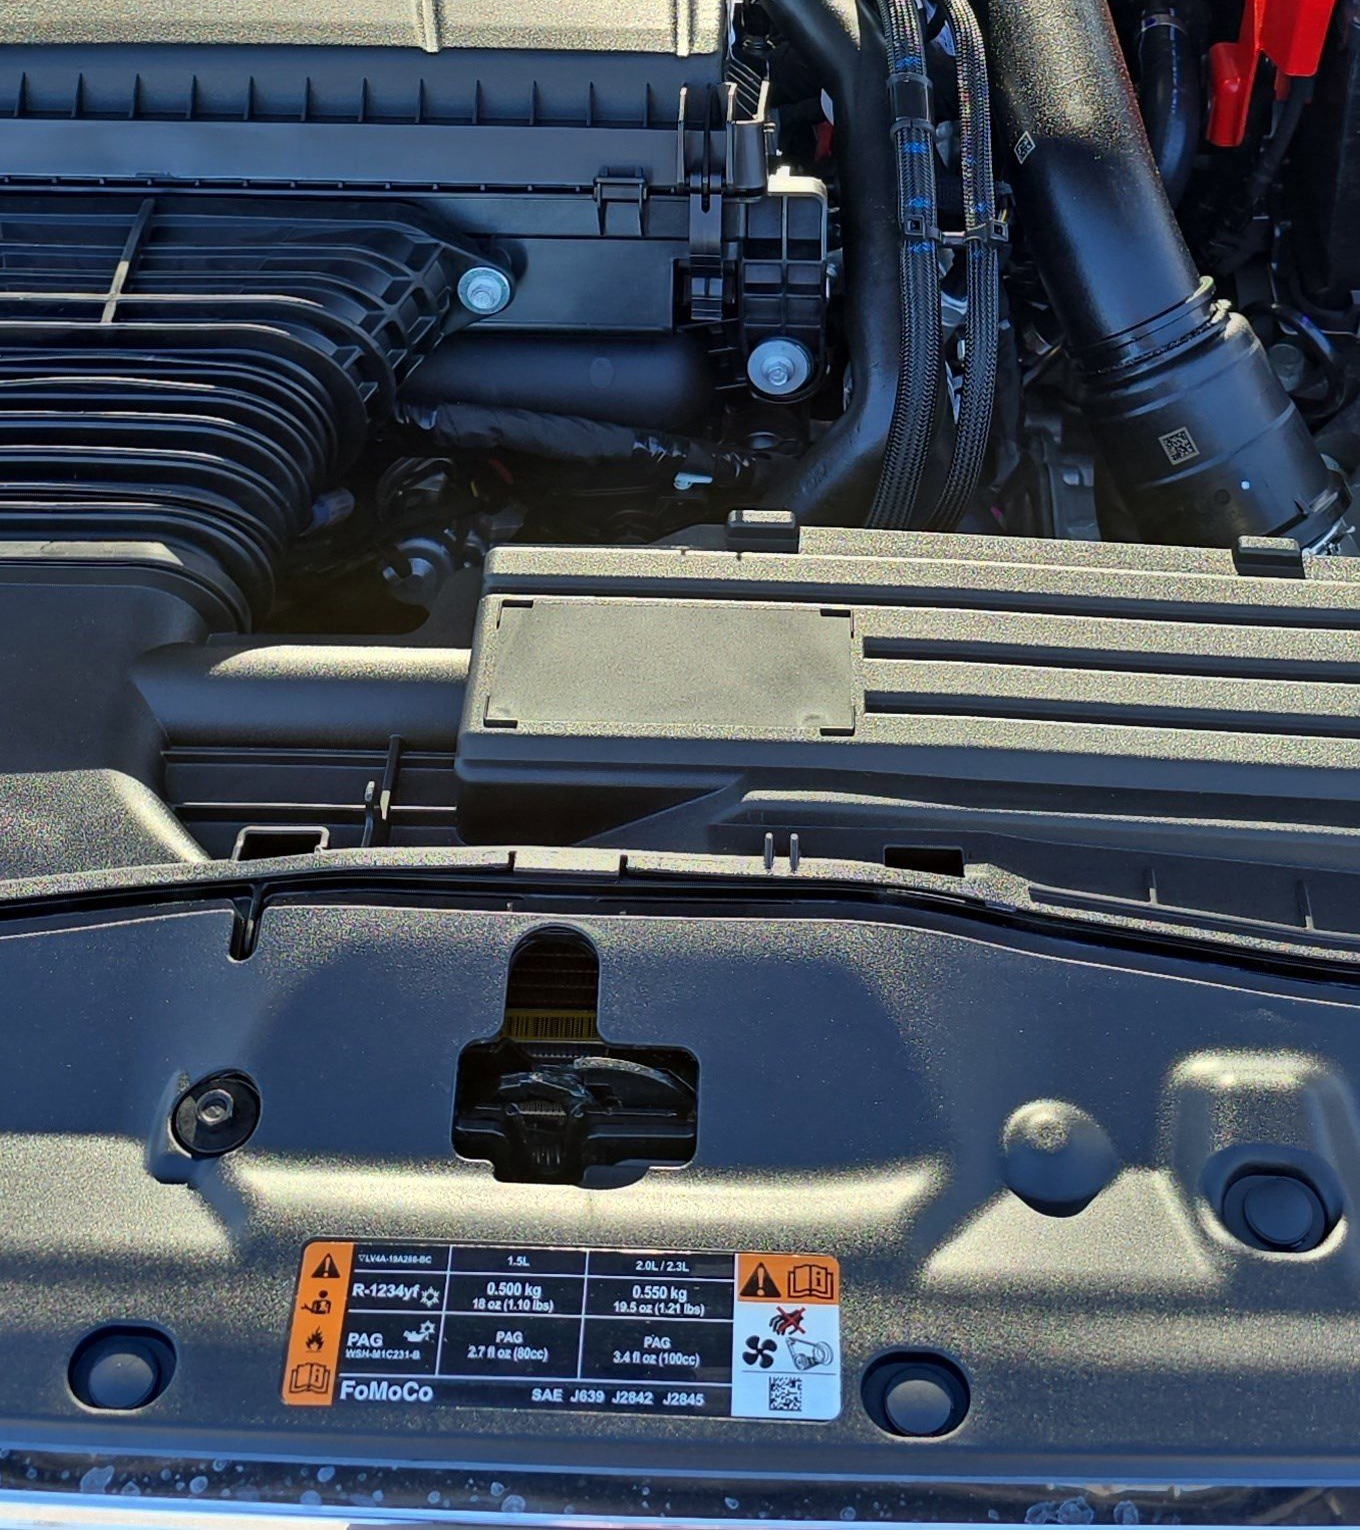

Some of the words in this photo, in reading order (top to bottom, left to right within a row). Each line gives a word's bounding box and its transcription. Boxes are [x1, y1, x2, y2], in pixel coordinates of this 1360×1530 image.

[507, 1255, 530, 1267] 1.5L
[635, 1260, 659, 1271] 2.0L
[666, 1261, 690, 1272] 2.3L
[352, 1282, 420, 1301] R-1234yf
[486, 1282, 522, 1296] 0.500
[524, 1282, 542, 1299] kg
[632, 1285, 668, 1299] 0.550
[670, 1286, 687, 1303] kg
[472, 1297, 486, 1310] 18
[487, 1300, 502, 1310] oz
[503, 1298, 531, 1312] (1.10
[532, 1299, 554, 1313] lbs)
[613, 1300, 637, 1313] 19.5
[638, 1303, 653, 1314] oz
[654, 1302, 681, 1316] (1.21
[683, 1303, 705, 1318] lbs)
[346, 1332, 383, 1348] PAG
[495, 1331, 524, 1344] PAG
[643, 1336, 672, 1349] PAG
[467, 1345, 486, 1359] 2.7
[486, 1346, 496, 1359] fl
[497, 1348, 512, 1359] oz
[513, 1347, 549, 1363] (80cc)
[612, 1350, 631, 1364] 3.4
[632, 1351, 641, 1364] fl
[642, 1354, 657, 1365] oz
[658, 1351, 700, 1368] (100cc)
[339, 1380, 434, 1403] FoMoCo
[531, 1388, 564, 1403] SAE
[569, 1389, 606, 1404] J639
[610, 1391, 654, 1405] J2842
[662, 1392, 706, 1407] J2845
